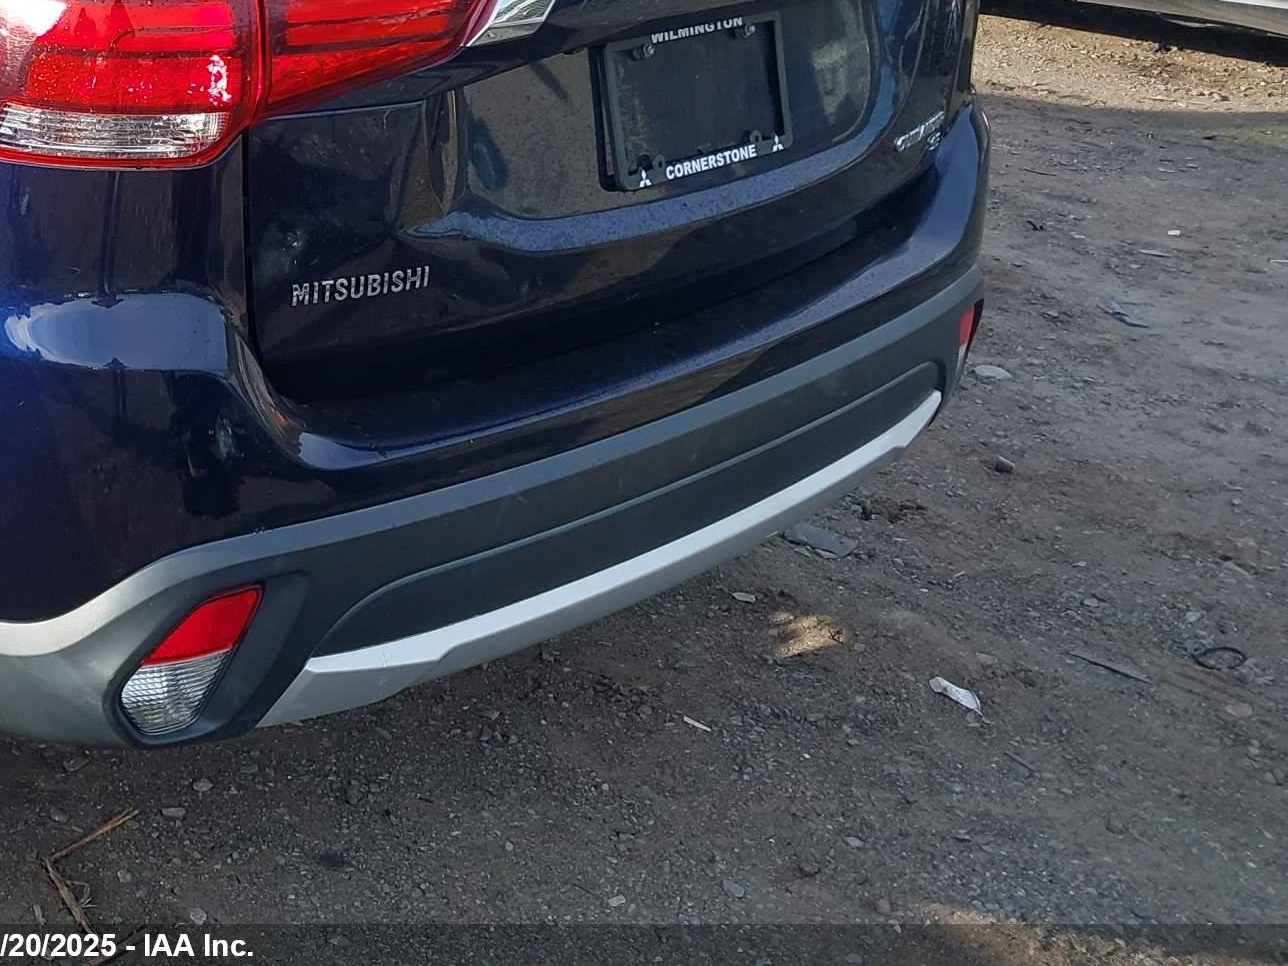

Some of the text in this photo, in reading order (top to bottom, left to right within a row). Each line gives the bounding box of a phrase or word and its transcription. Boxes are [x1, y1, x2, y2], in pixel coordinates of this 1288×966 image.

[651, 17, 743, 44] WILMINGTON
[665, 144, 757, 180] CORNERSTONE
[291, 266, 430, 307] MITSUBISHI
